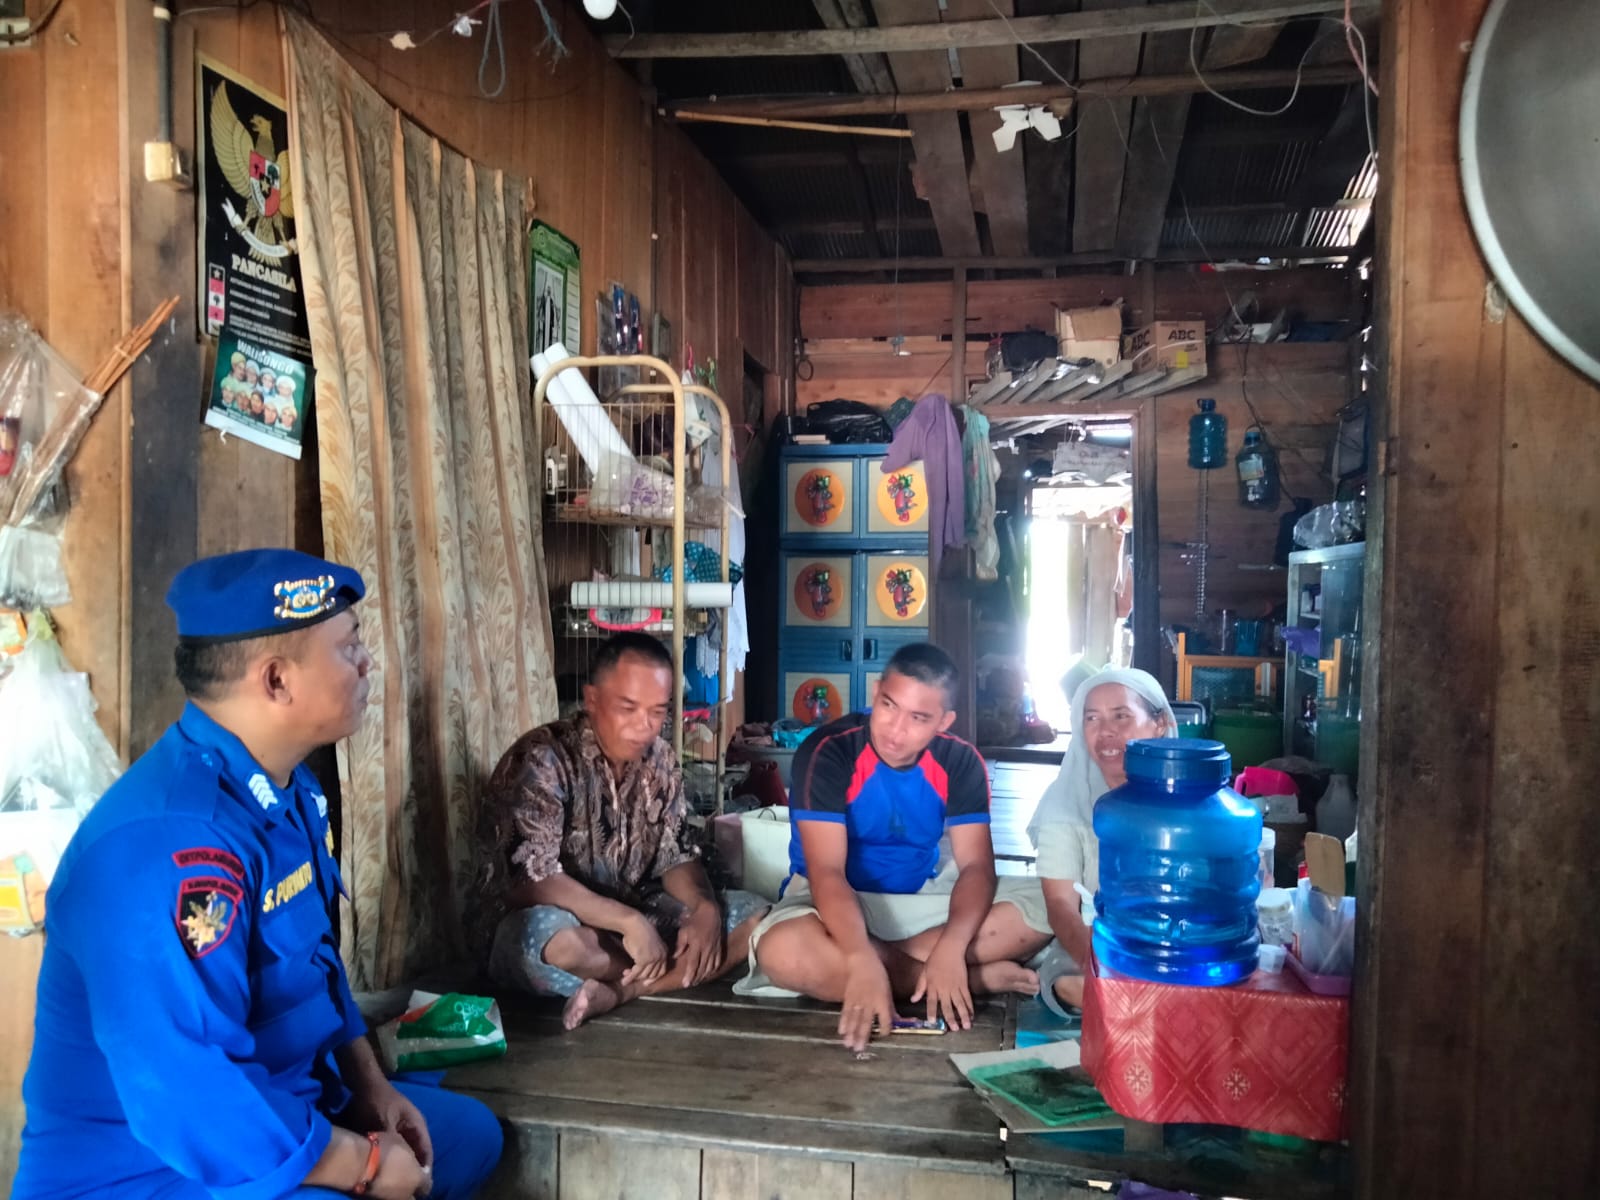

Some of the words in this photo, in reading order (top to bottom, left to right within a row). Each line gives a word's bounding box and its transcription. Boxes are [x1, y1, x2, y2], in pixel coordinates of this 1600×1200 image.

[231, 253, 297, 293] PANCASILA
[1132, 329, 1150, 352] ABC
[1167, 329, 1196, 341] ABC
[237, 339, 294, 375] WALISONGO
